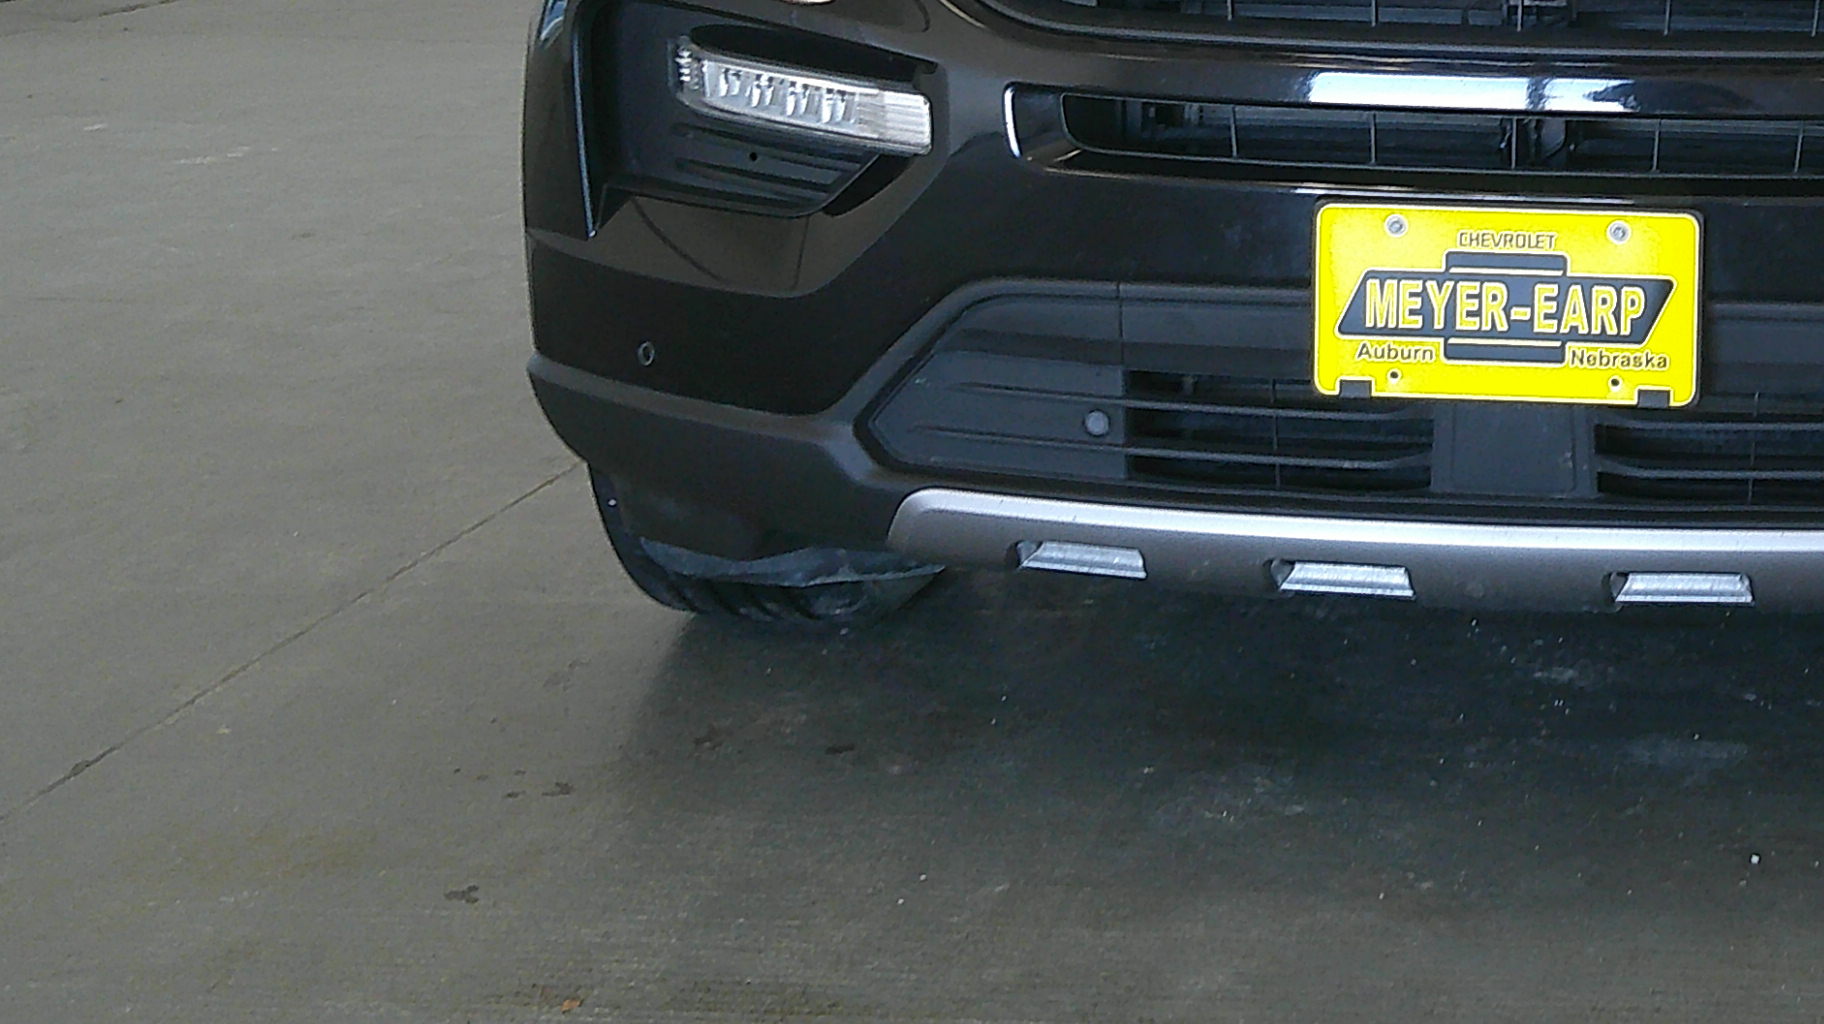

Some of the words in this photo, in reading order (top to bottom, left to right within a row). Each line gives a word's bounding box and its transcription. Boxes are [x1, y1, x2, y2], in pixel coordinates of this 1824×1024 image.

[1458, 232, 1556, 250] CHEVROLET
[1364, 278, 1647, 336] MEYER-EARP
[1357, 342, 1434, 361] Auburn
[1570, 349, 1669, 369] Nebraska
